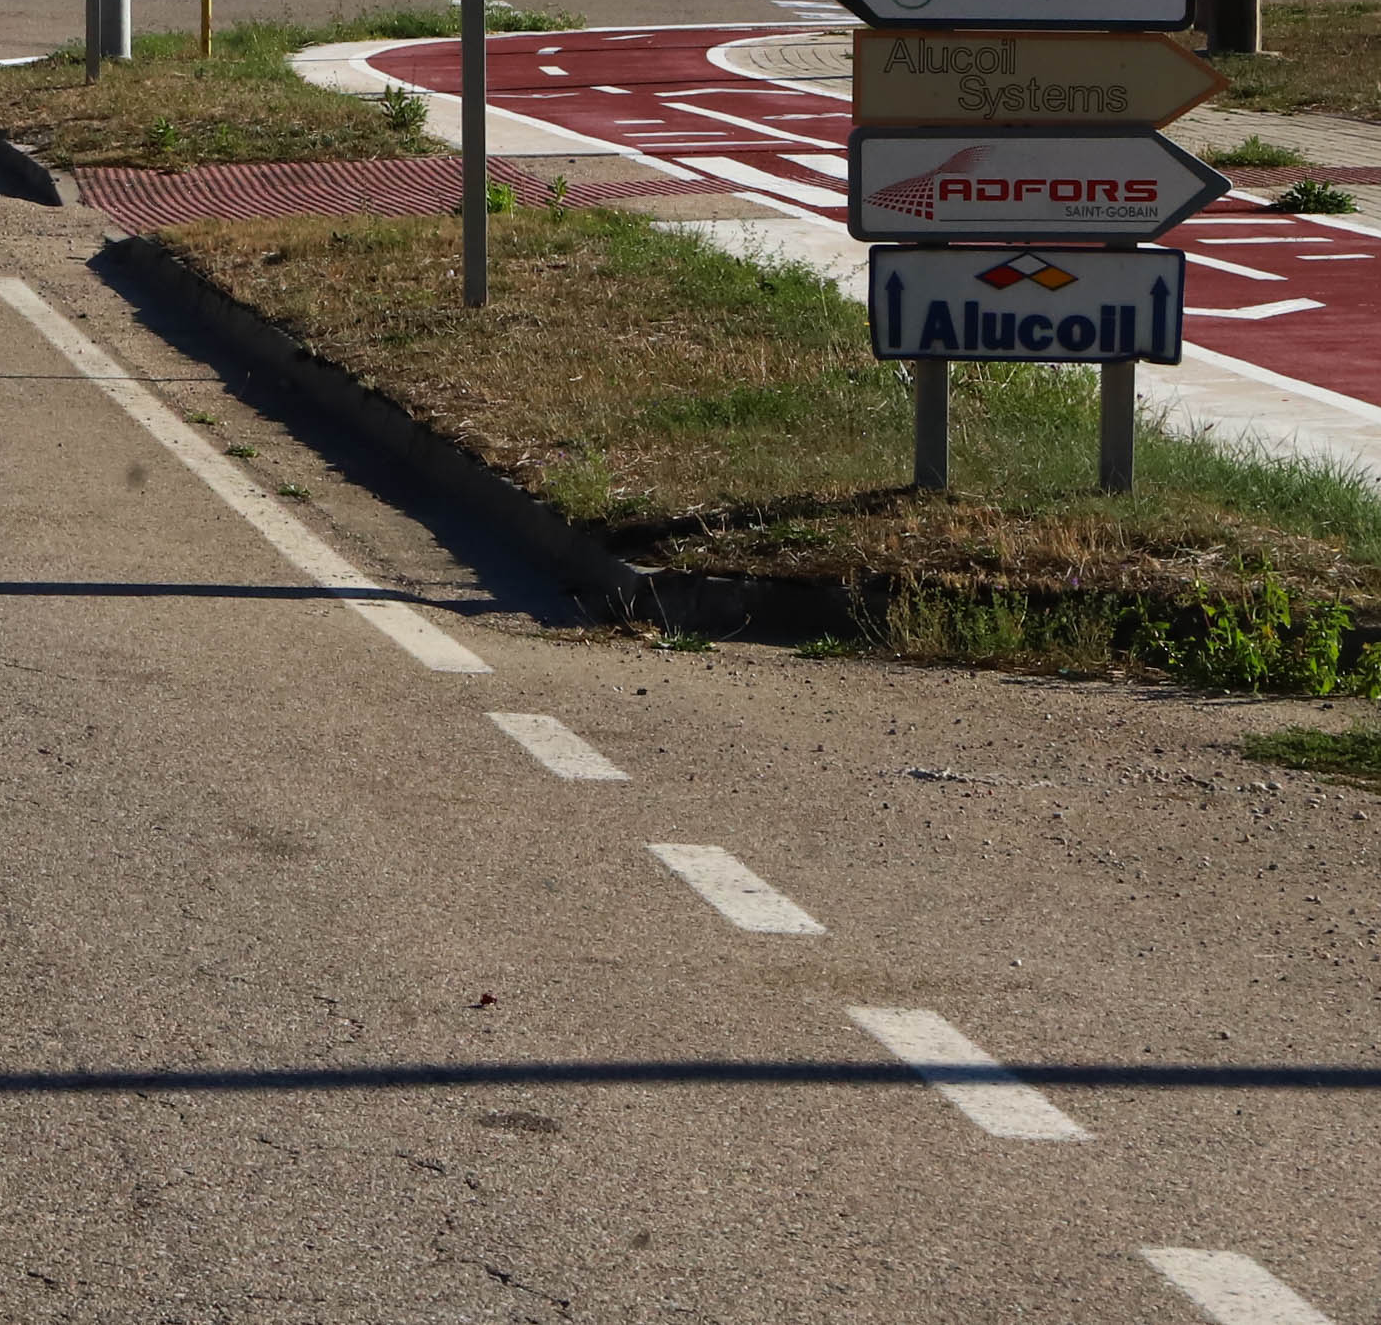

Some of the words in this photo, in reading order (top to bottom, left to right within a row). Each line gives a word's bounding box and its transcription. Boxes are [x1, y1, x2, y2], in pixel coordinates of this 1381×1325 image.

[883, 38, 1017, 75] Alucoil
[958, 75, 1128, 119] Systems
[939, 179, 1158, 202] ADFORS
[1065, 206, 1158, 218] SAINT-GOBAIN
[919, 301, 1136, 353] Alucoil
